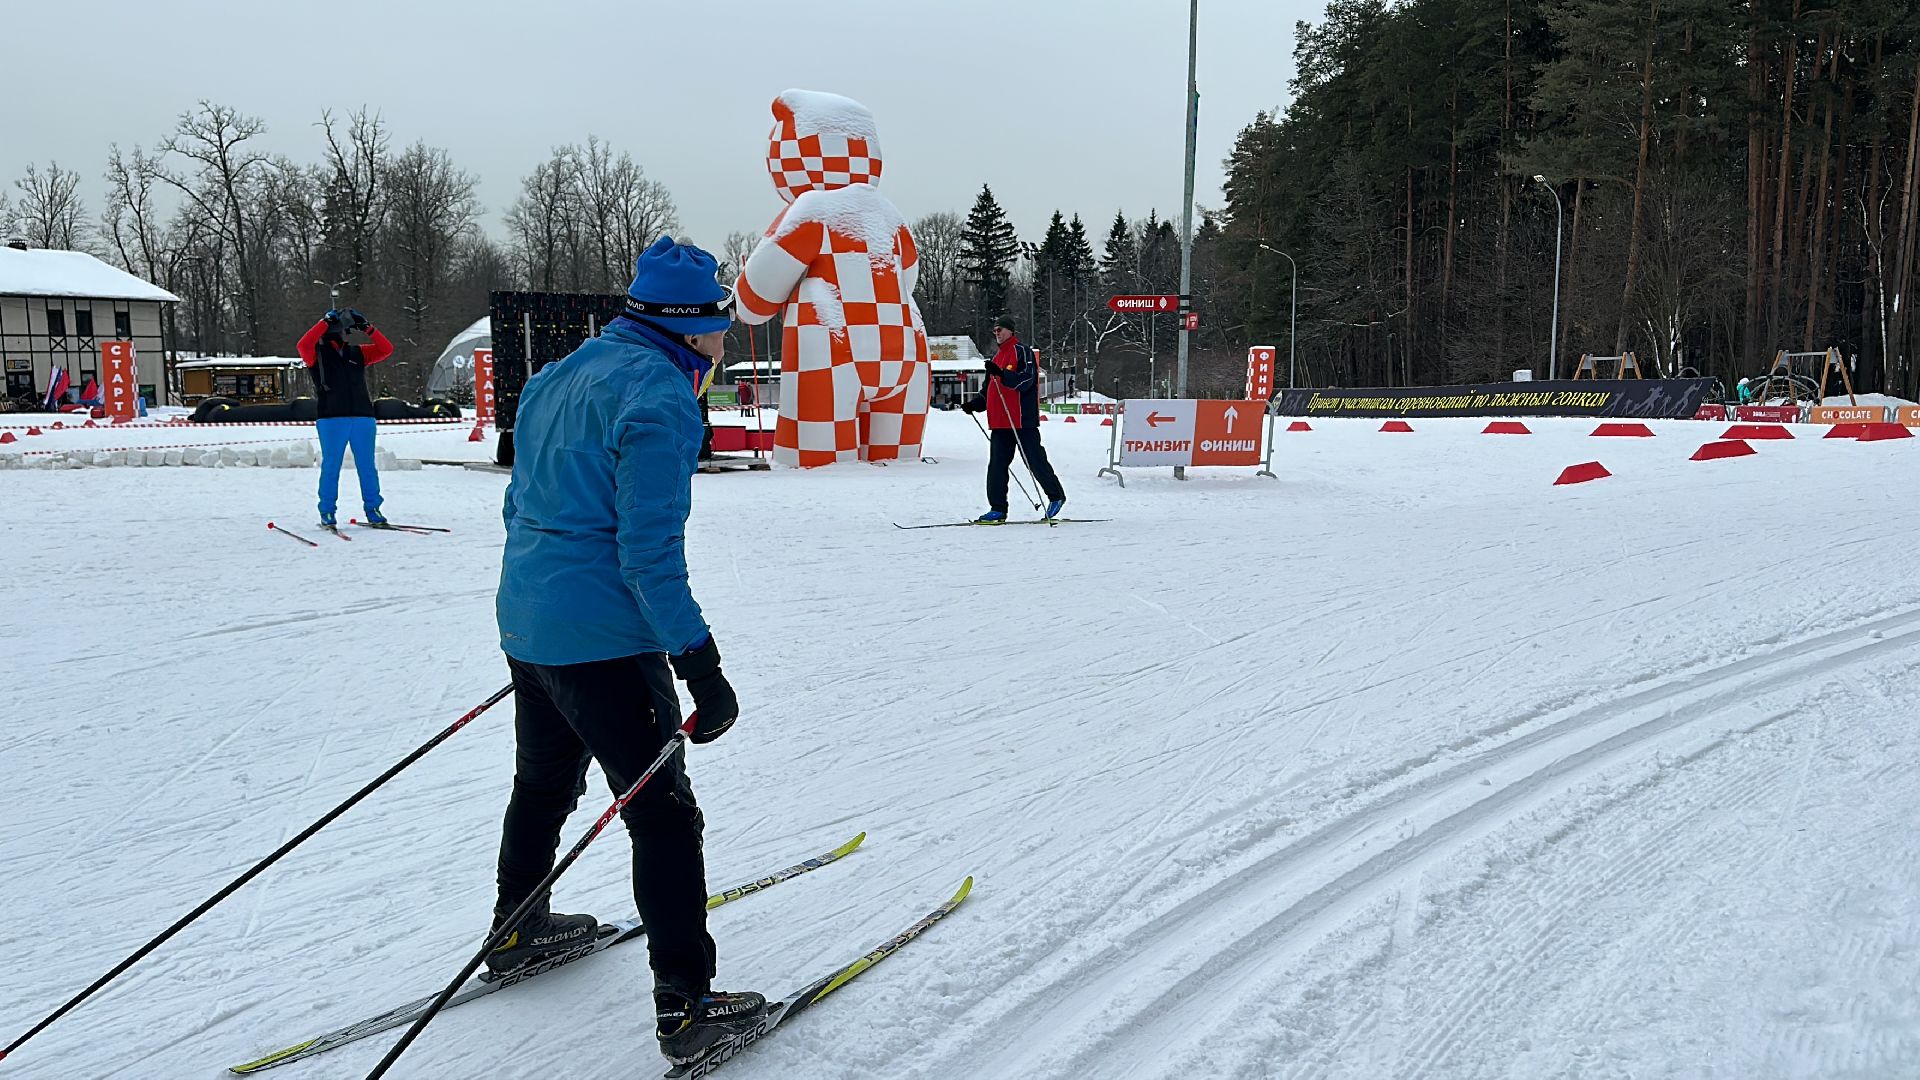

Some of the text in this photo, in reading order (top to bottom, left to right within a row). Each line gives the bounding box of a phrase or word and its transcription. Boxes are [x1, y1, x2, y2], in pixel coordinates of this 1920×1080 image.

[1116, 299, 1154, 308] ФИНИШ
[110, 345, 124, 411] СТАРТ
[482, 354, 495, 415] СТАРТ
[1257, 351, 1269, 401] ФИНИ
[1307, 389, 1610, 414] Привет участникам соревнований по лыжным гонкам
[1821, 410, 1871, 419] CHOCOLATE
[1125, 440, 1191, 452] ТРАНЗИТ
[1200, 439, 1255, 452] ФИНИШ
[530, 924, 588, 946] SALOMON
[499, 944, 595, 990] FISCHER
[706, 998, 760, 1018] SALOMON
[691, 1021, 767, 1080] FISCHER
